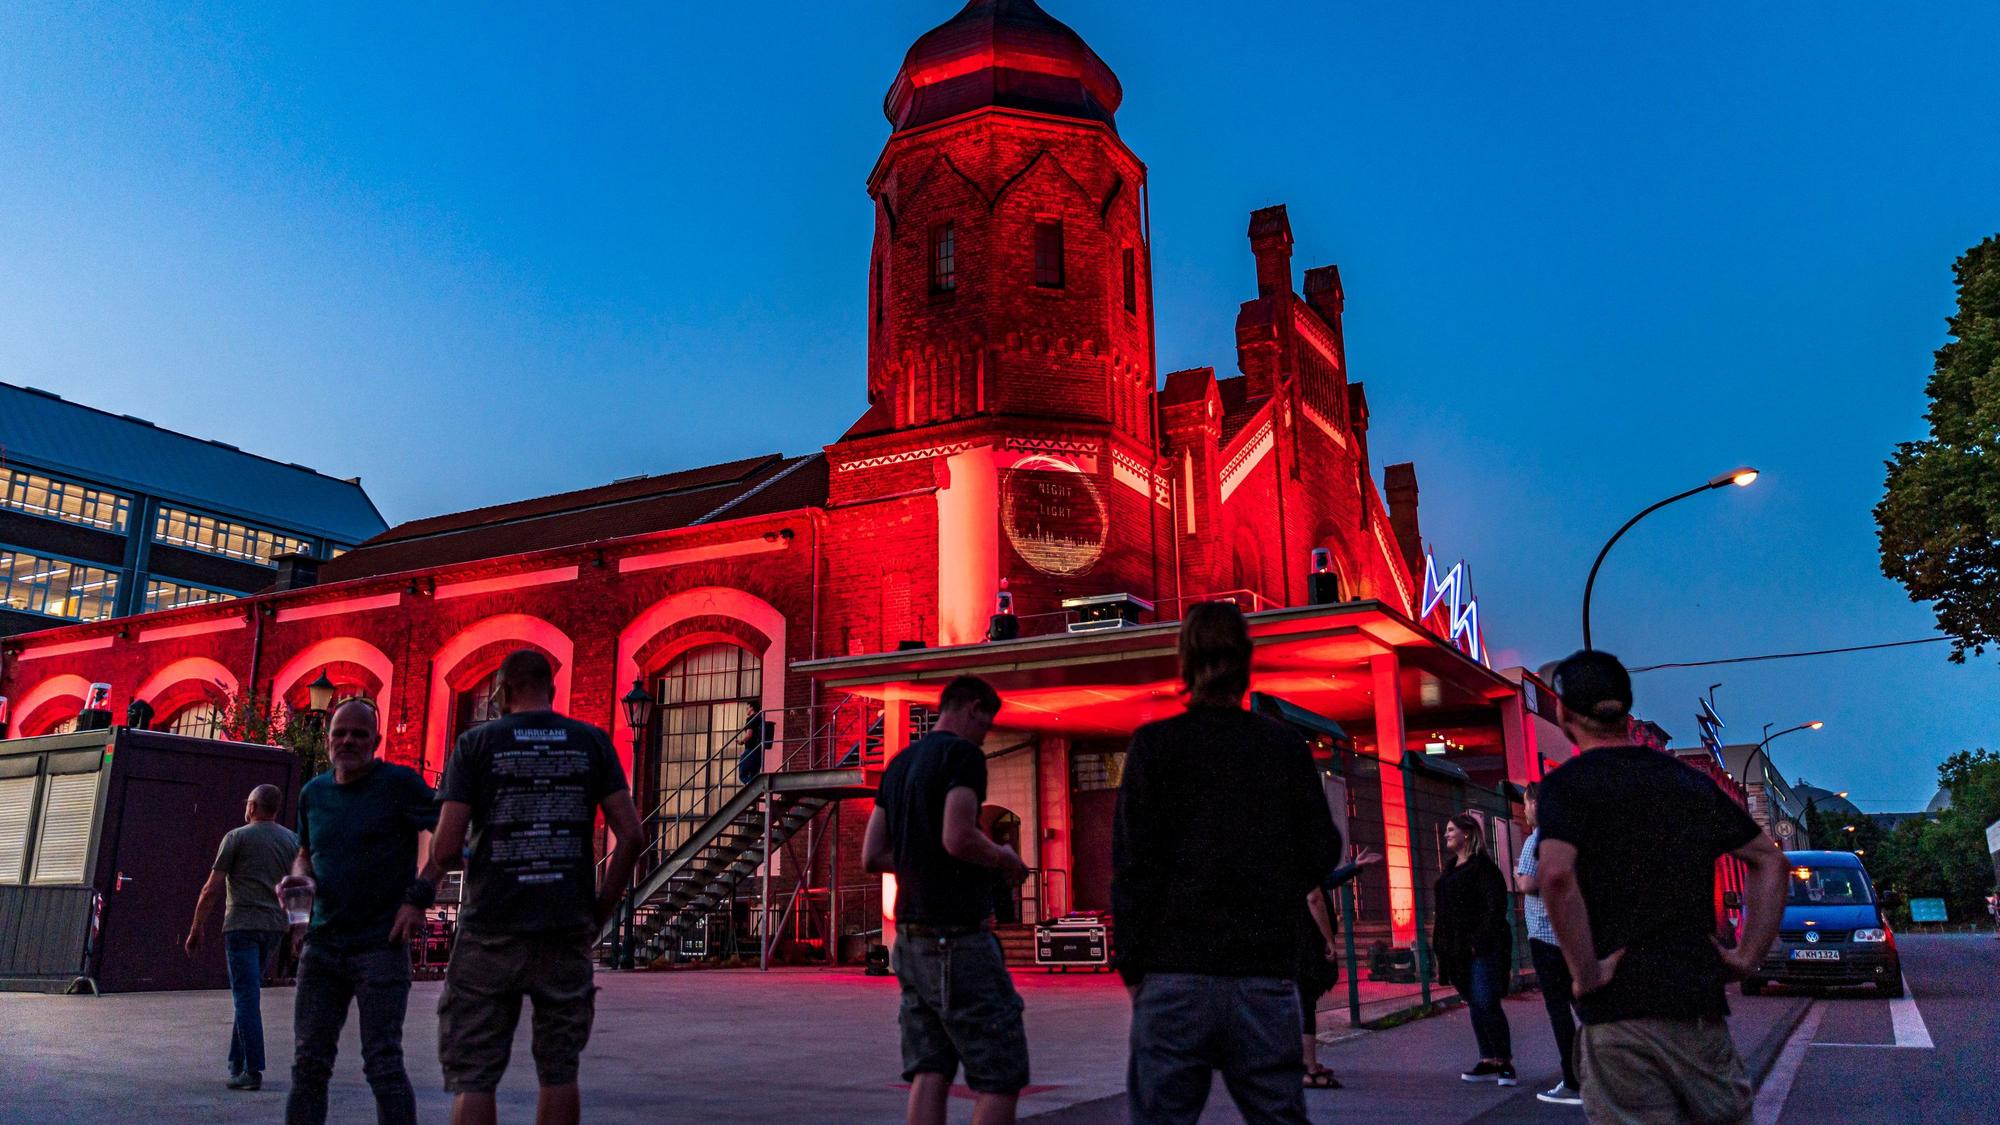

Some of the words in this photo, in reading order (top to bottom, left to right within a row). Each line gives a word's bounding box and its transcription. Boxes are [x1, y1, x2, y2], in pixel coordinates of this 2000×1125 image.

[1039, 483, 1072, 497] NIGHT
[1040, 504, 1072, 518] LIGHT
[514, 728, 567, 737] HURRICANE
